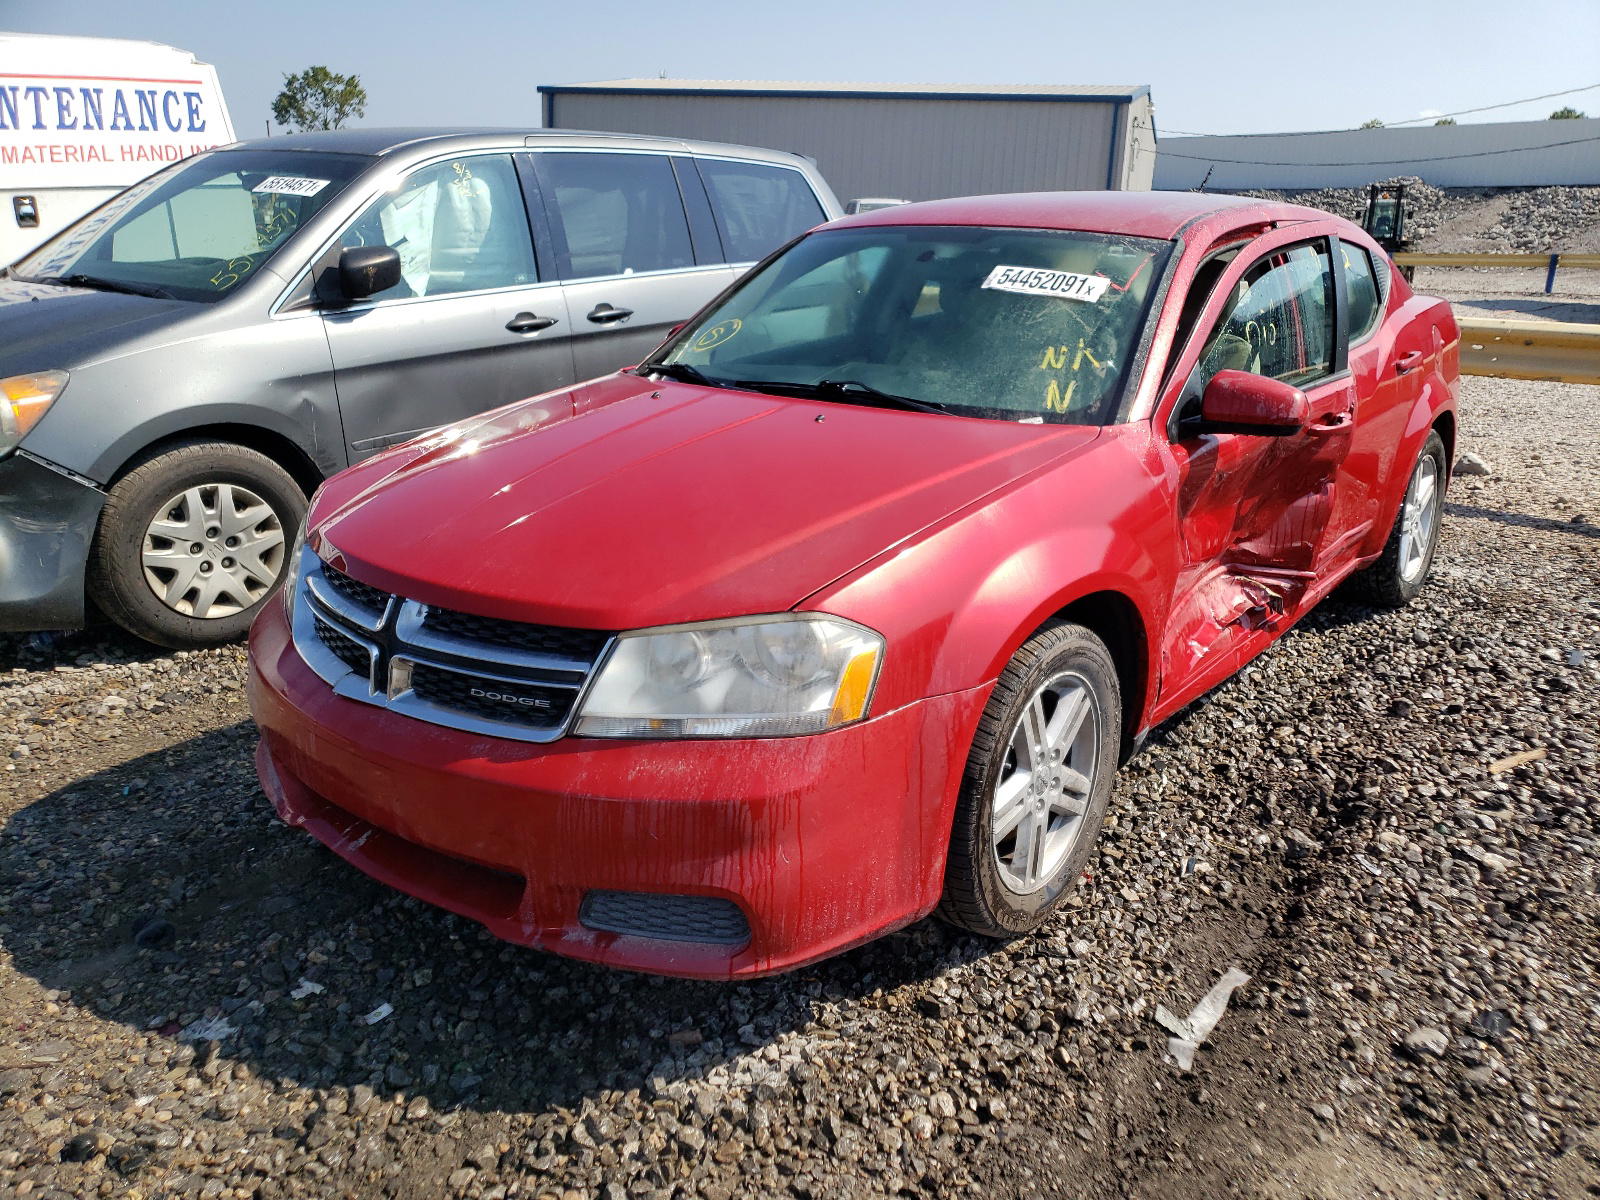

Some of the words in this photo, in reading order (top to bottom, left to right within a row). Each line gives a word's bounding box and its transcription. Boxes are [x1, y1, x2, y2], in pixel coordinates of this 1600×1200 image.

[0, 85, 206, 133] NTENANCE
[2, 144, 114, 164] MATERIAL
[120, 144, 219, 162] HANDLI
[470, 688, 551, 708] DODGE
